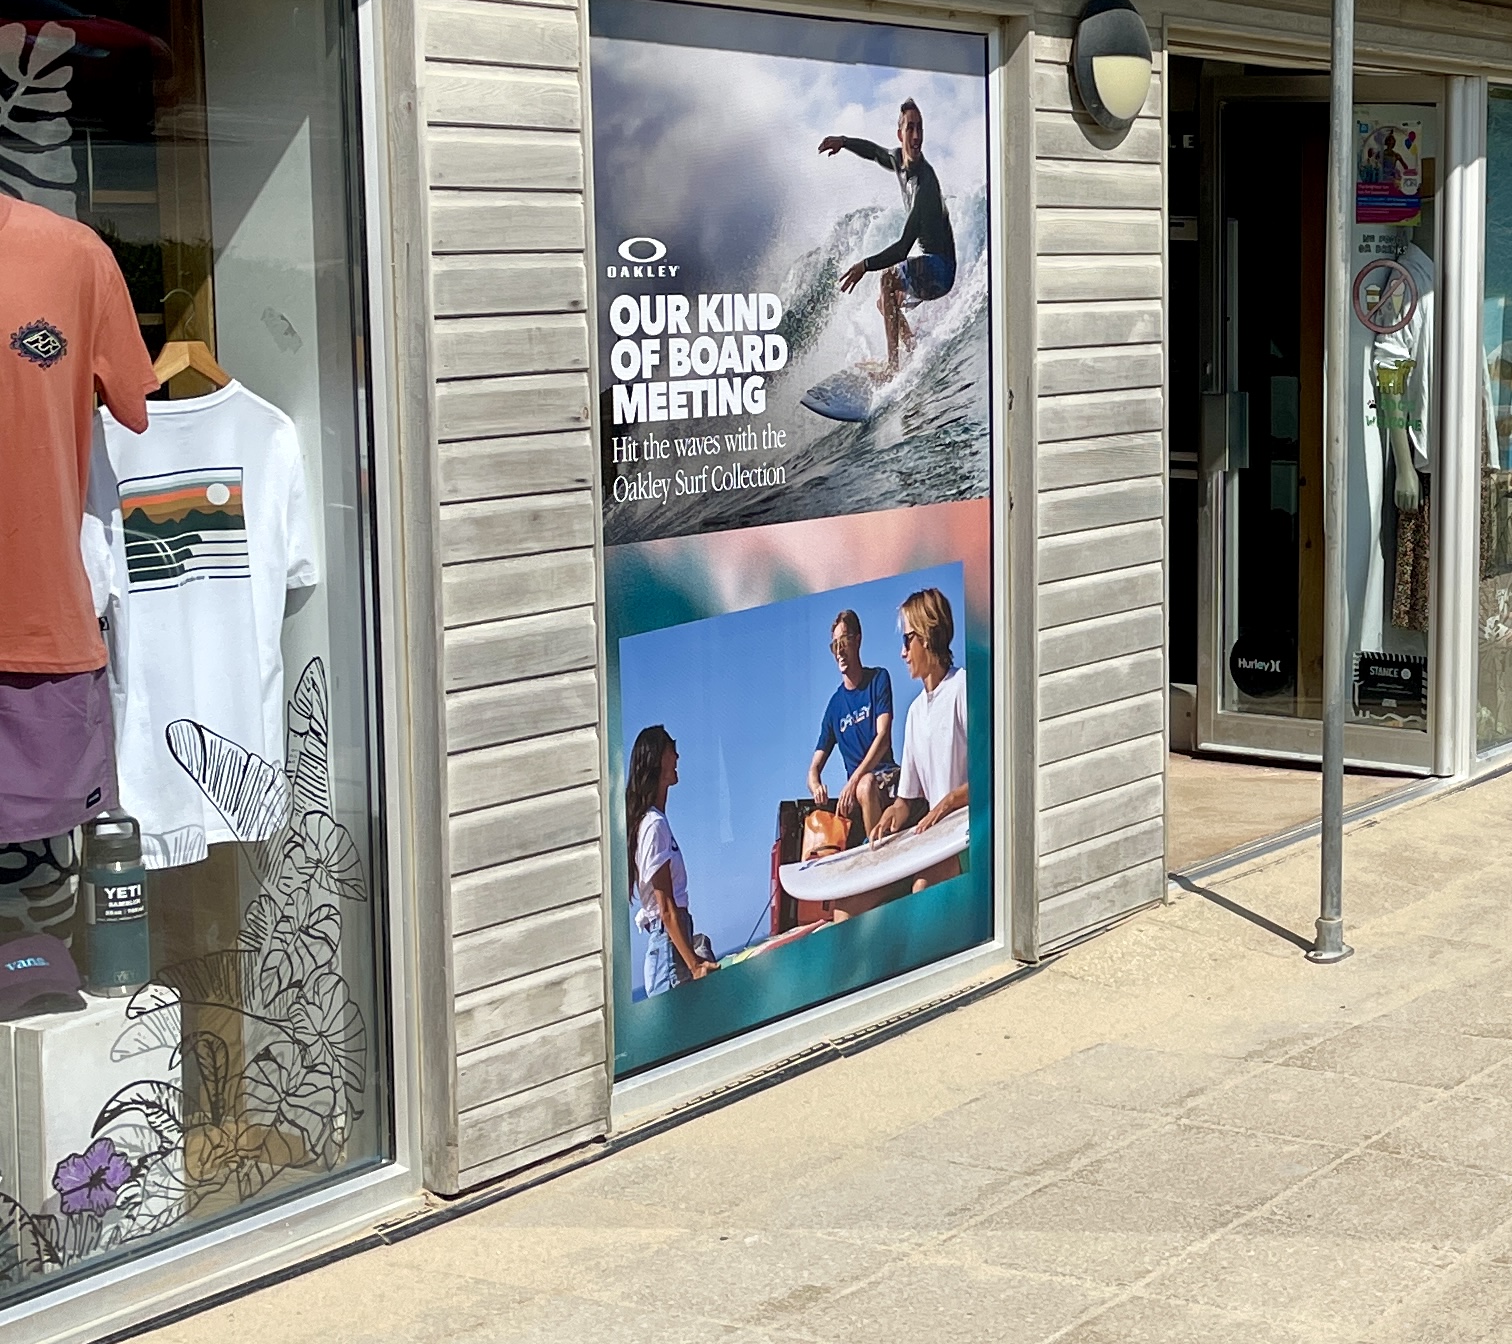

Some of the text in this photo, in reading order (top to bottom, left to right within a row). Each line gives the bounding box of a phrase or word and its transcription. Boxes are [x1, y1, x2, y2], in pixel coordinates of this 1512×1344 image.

[607, 265, 679, 278] OAKLEY
[609, 293, 783, 337] OUR KIND
[611, 334, 788, 381] OF BOARD
[612, 375, 766, 425] MEETING
[612, 422, 787, 464] Hit the waves with the
[613, 461, 786, 504] Oakley Surf Collection
[1238, 658, 1270, 672] Hurley
[1370, 666, 1398, 678] STANCE
[104, 884, 141, 900] YETI
